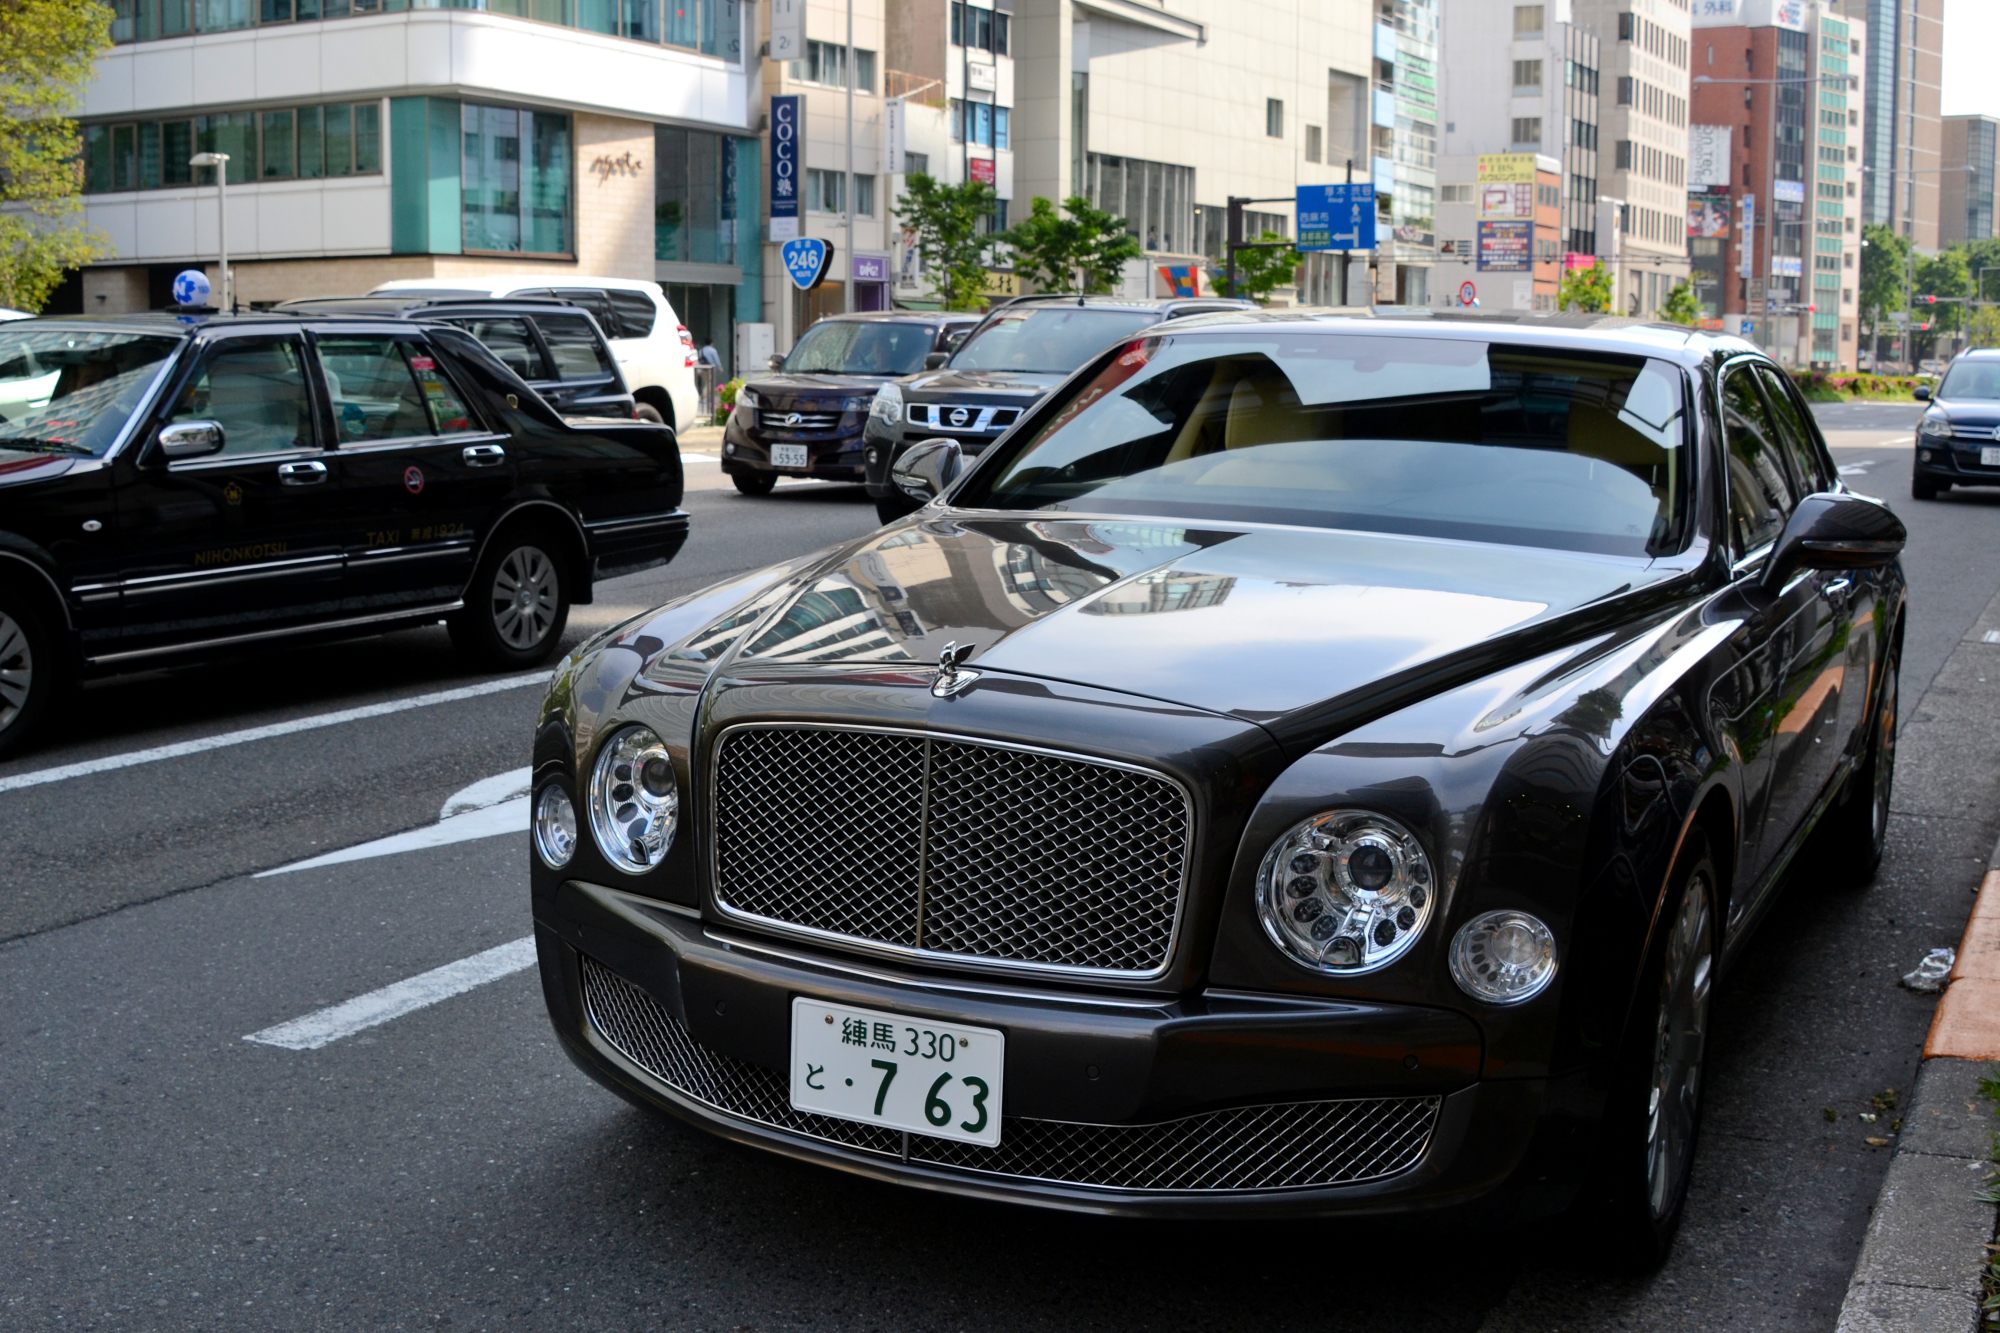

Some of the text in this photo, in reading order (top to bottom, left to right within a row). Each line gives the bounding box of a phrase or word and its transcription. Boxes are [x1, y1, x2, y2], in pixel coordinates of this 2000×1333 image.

[789, 250, 818, 270] 246
[367, 529, 399, 546] TAXI
[194, 542, 287, 566] NIHONKOTSU
[841, 1017, 955, 1062] 練馬 330
[806, 1062, 825, 1090] と
